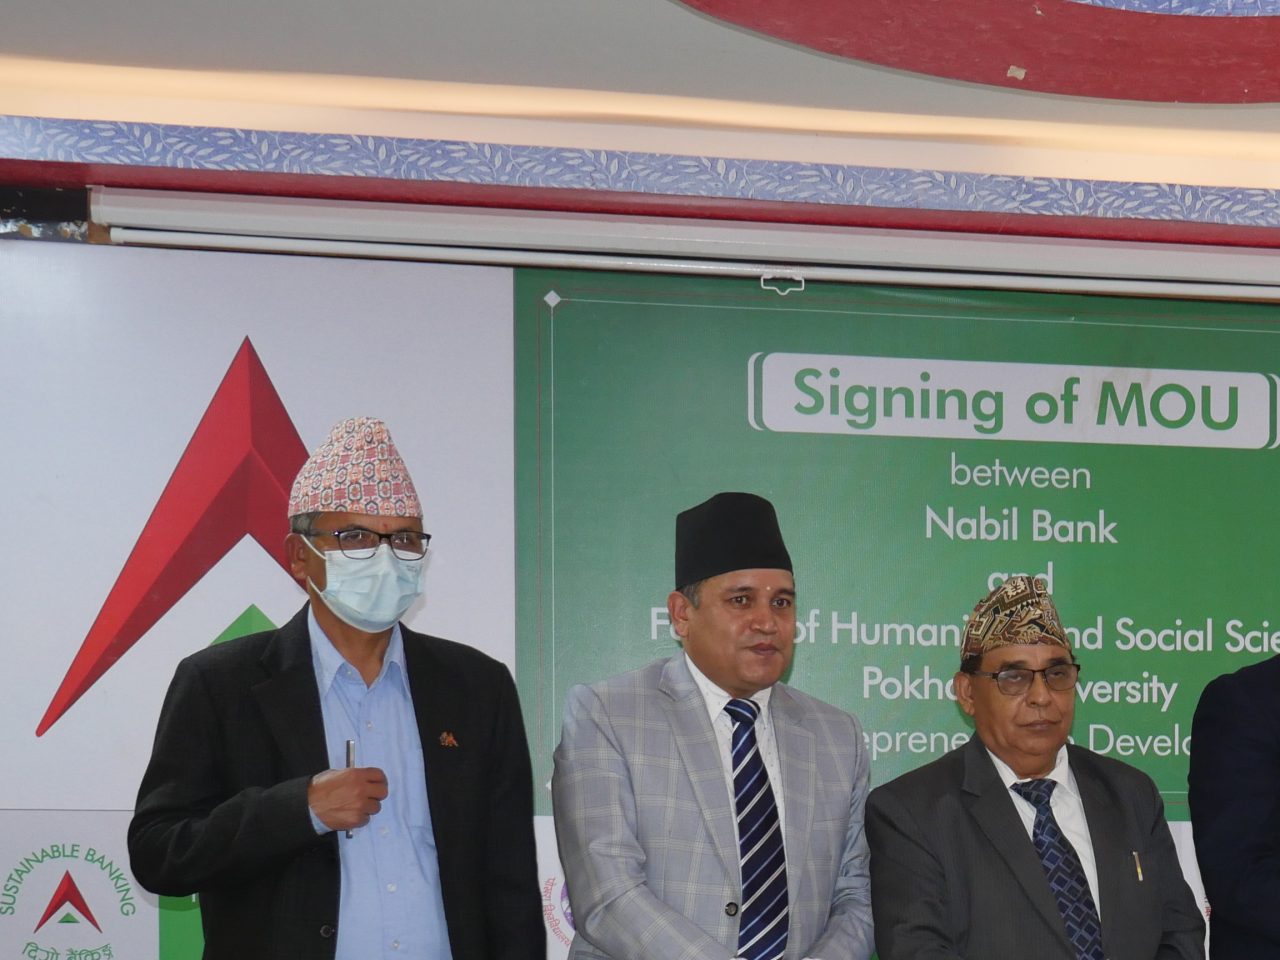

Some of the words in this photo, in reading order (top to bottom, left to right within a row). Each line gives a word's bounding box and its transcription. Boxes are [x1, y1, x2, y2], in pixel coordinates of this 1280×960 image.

[794, 366, 1004, 435] Signing
[1025, 377, 1080, 425] of
[1096, 381, 1239, 432] MOU
[951, 452, 1091, 490] between
[926, 505, 1018, 543] Nabil
[1032, 509, 1118, 545] Bank
[831, 611, 968, 647] Human
[1065, 615, 1103, 651] nd
[1115, 617, 1213, 652] Social
[1075, 672, 1178, 712] versity
[0, 843, 80, 916] SUSTAINABLE
[84, 847, 137, 917] BANKING
